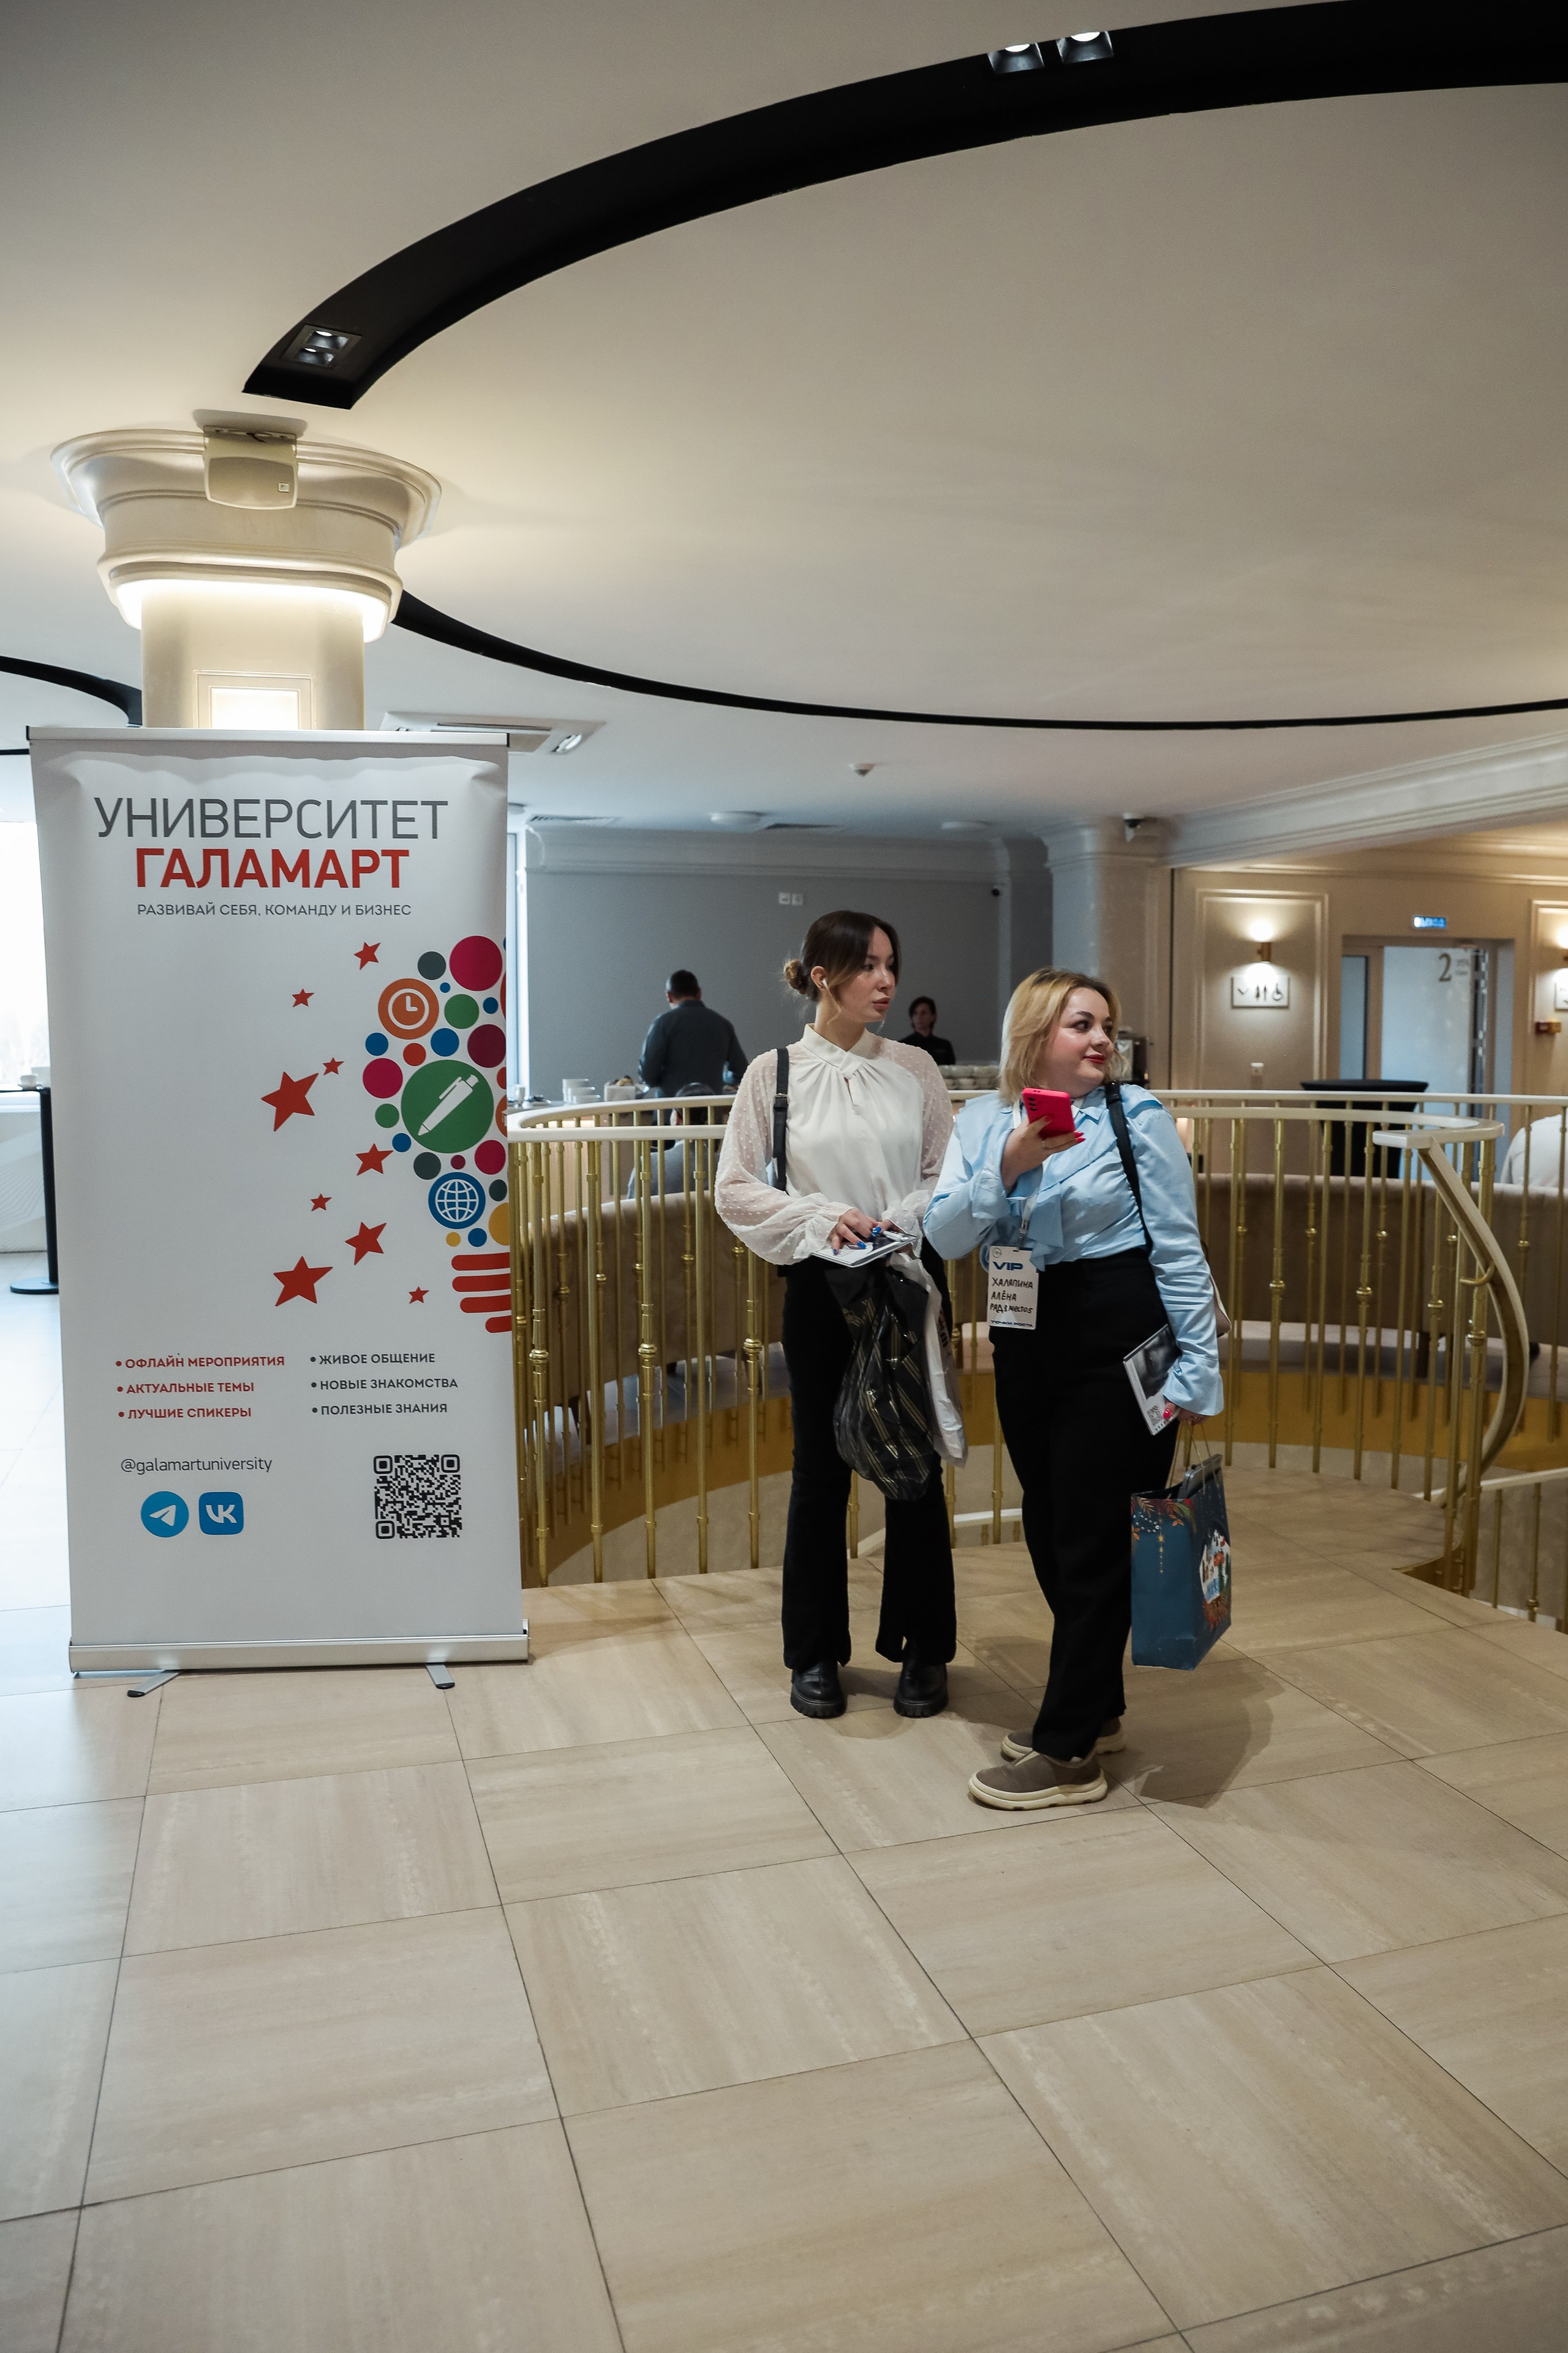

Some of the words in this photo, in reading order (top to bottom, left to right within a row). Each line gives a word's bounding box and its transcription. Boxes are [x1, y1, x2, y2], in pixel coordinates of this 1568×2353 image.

[93, 796, 448, 839] УНИВЕРСИТЕТ
[136, 848, 410, 888] ГАЛАМАРТ
[137, 901, 215, 915] РАЗВИВАЙ
[219, 904, 261, 917] СЕБЯ,
[265, 904, 337, 918] КОМАНДУ
[341, 905, 351, 915] И
[355, 904, 412, 916] БИЗНЕС
[1438, 952, 1452, 982] 2
[992, 1261, 1023, 1271] VIP
[992, 1277, 1033, 1289] ХАЛЯПИНА
[990, 1290, 1017, 1301] АЛЁНА
[125, 1353, 184, 1369] ОФЛАЙН
[187, 1356, 285, 1367] МЕРОПРИЯТИЯ
[318, 1354, 368, 1365] ЖИВОЕ
[371, 1353, 435, 1365] ОБЩЕНИЕ
[126, 1383, 214, 1394] АКТУАЛЬНЫЕ
[217, 1382, 254, 1392] ТЕМЫ
[320, 1379, 367, 1390] НОВЫЕ
[370, 1378, 458, 1389] ЗНАКОМСТВА
[127, 1408, 184, 1419] ЛУЧШИЕ
[187, 1407, 251, 1418] СПИКЕРЫ
[321, 1404, 393, 1416] ПОЛЕЗНЫЕ
[395, 1403, 447, 1413] ЗНАНИЯ
[121, 1456, 273, 1475] @galamartuniversity
